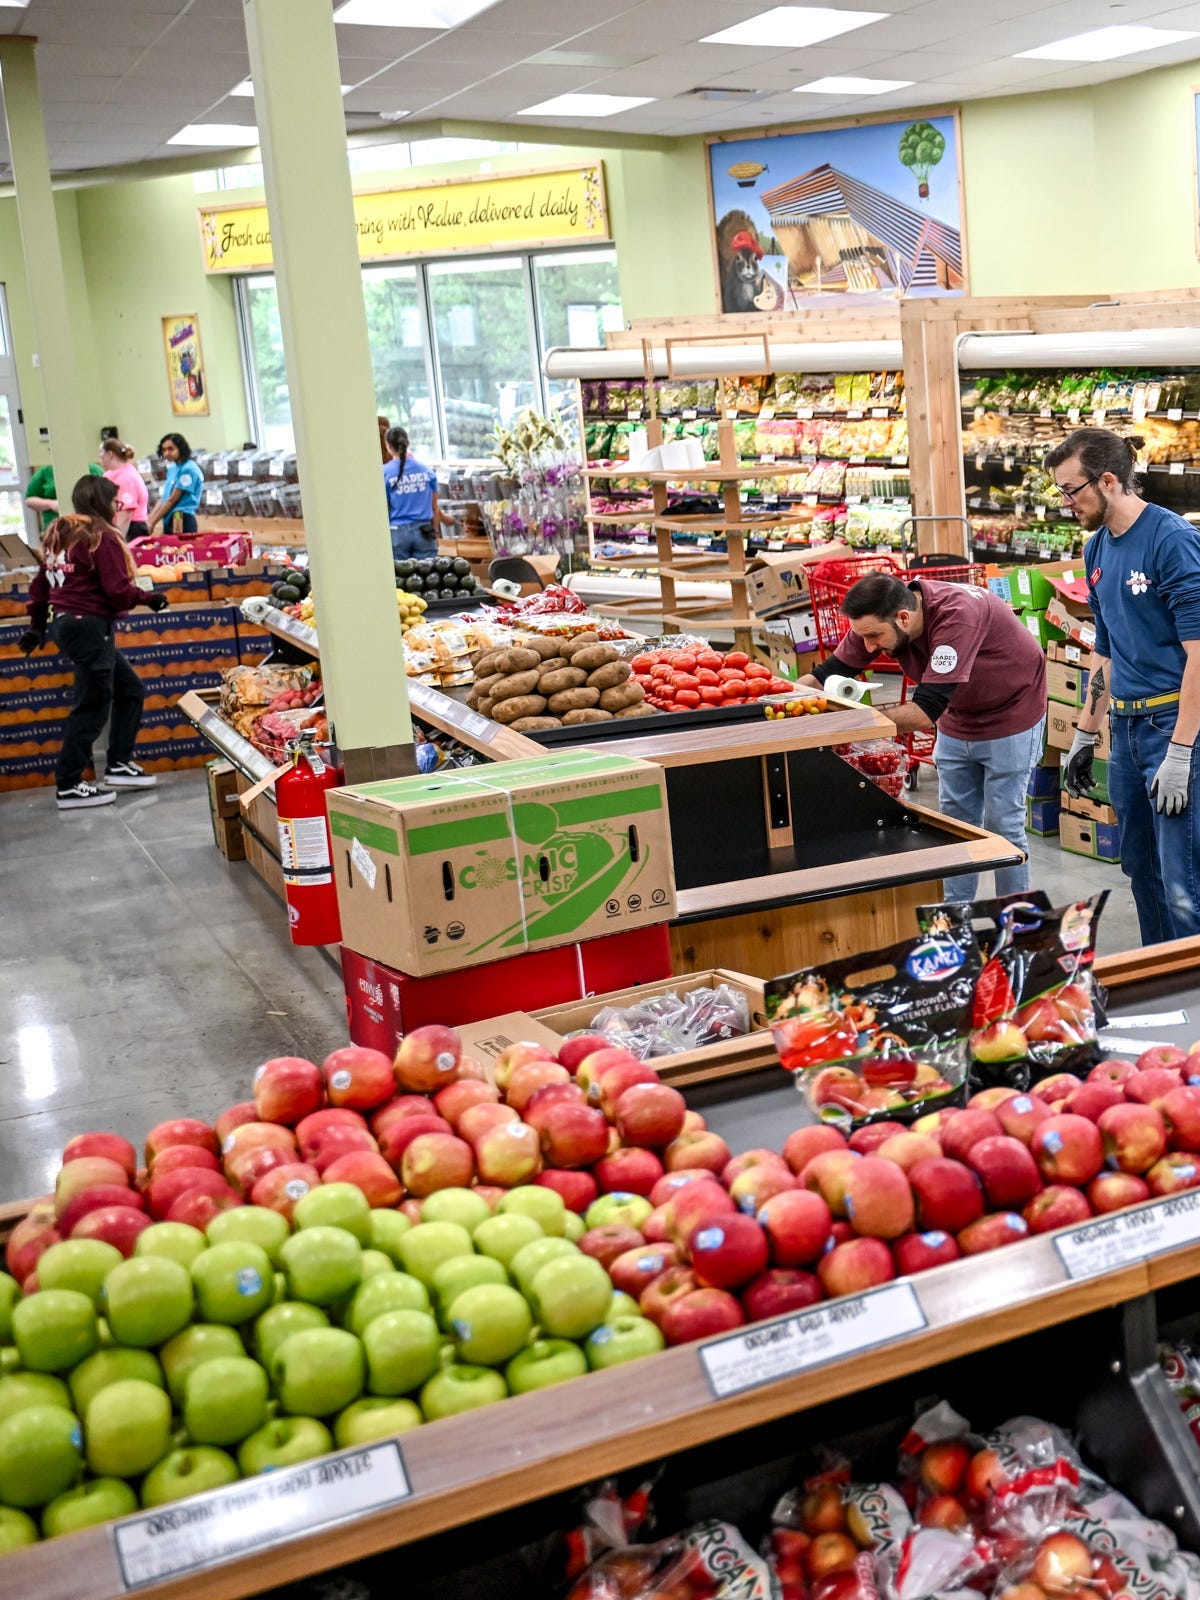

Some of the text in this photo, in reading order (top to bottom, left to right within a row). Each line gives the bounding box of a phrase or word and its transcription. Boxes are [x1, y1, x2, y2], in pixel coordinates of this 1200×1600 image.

[221, 222, 253, 253] Fresh
[386, 209, 416, 232] with
[469, 193, 534, 224] delivered
[540, 187, 579, 226] daily
[116, 612, 229, 630] Premium Citrus
[432, 774, 640, 815] AMAZING FLAVR INFINITE POSSIBILITIES
[520, 873, 573, 898] CRISP
[911, 950, 959, 974] KANZI
[893, 1007, 933, 1022] INTENSE
[1072, 1220, 1119, 1247] ORGANIC
